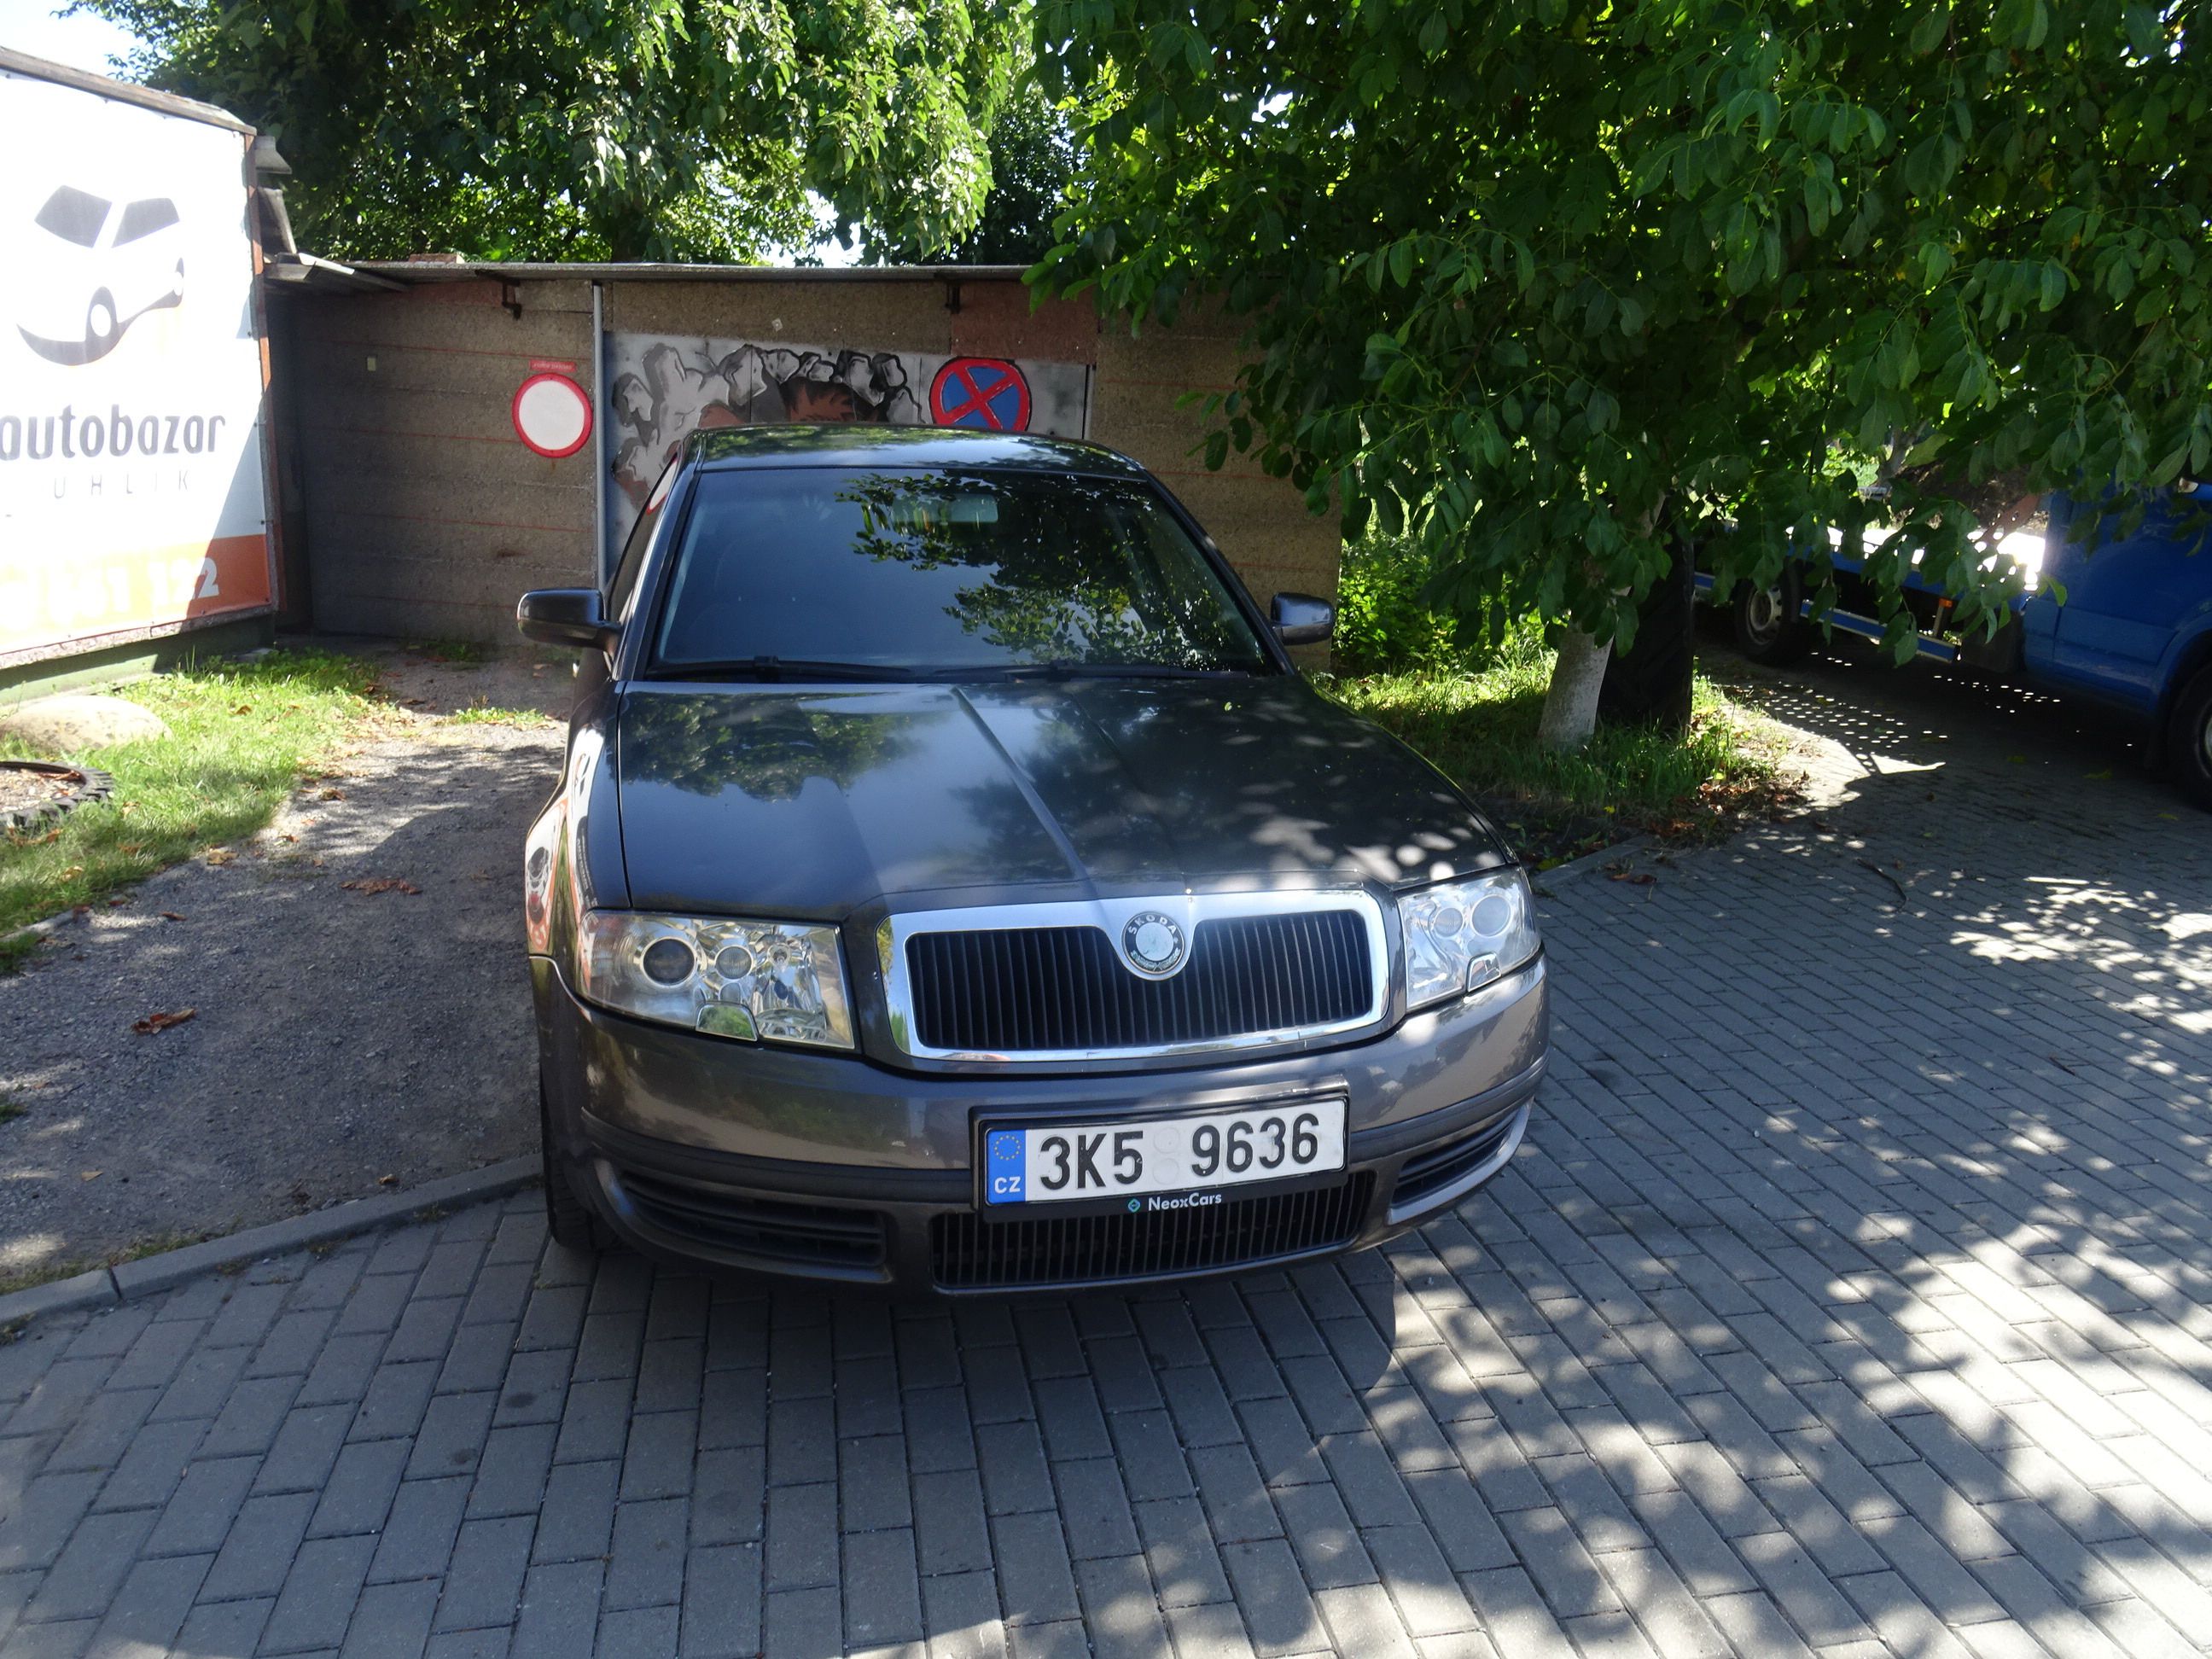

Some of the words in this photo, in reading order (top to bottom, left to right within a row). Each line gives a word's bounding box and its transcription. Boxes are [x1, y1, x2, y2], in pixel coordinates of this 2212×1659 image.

[0, 404, 226, 461] autobazar
[1039, 1130, 1144, 1190] 3K5
[1191, 1113, 1319, 1177] 9636
[994, 1176, 1021, 1194] CZ
[1148, 1192, 1222, 1211] NeoxCars
